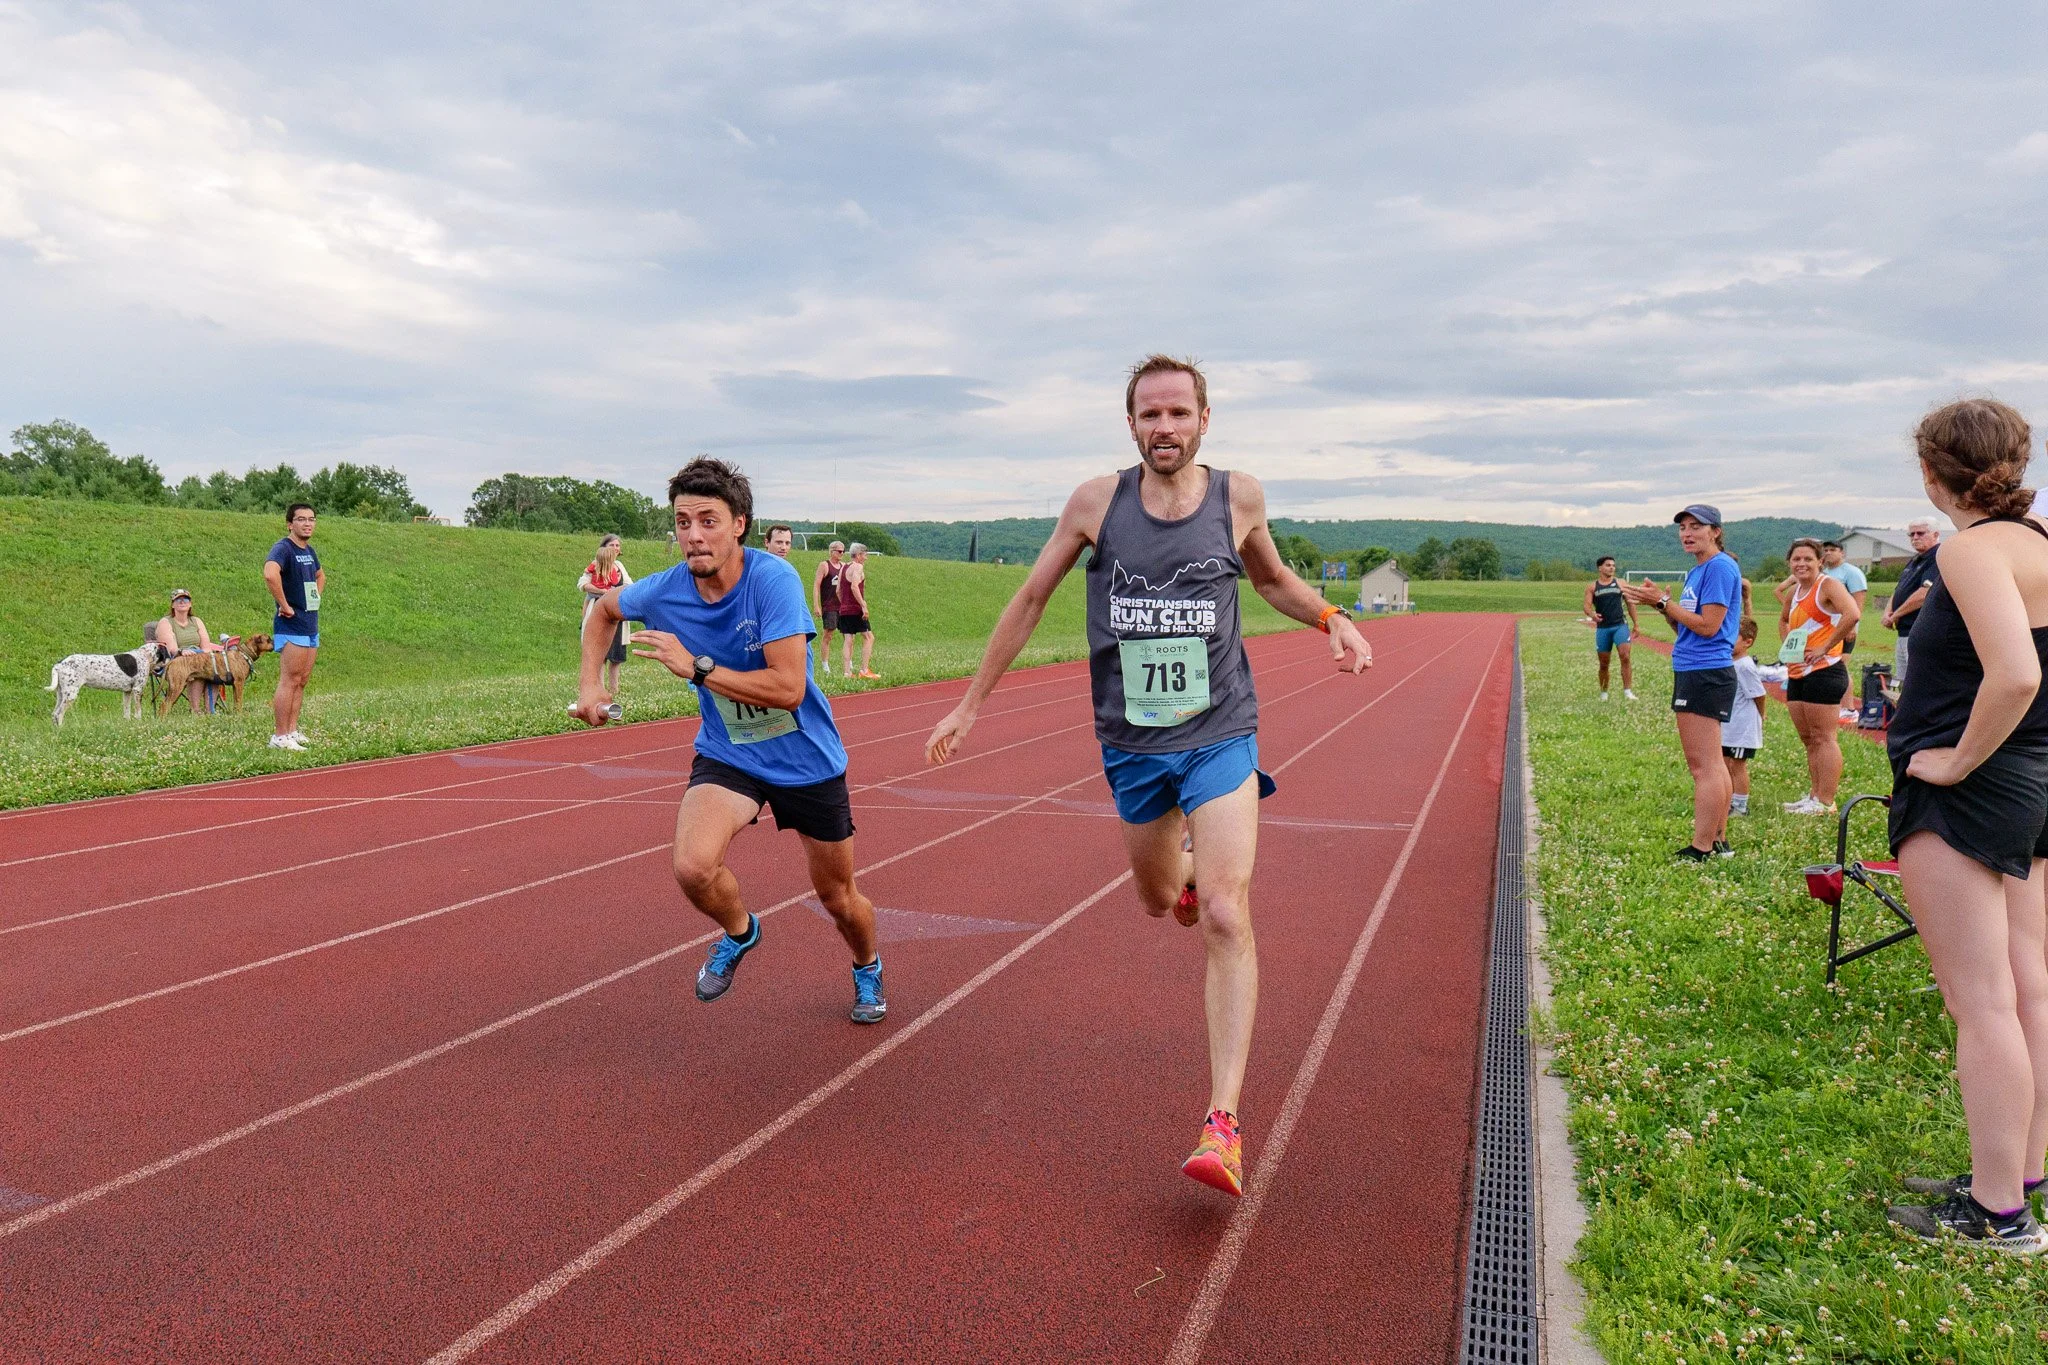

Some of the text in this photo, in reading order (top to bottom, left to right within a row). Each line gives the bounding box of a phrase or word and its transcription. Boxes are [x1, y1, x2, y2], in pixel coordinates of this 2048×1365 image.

[1110, 595, 1216, 610] CHRISTIANSBURG
[1110, 605, 1216, 626] RUN CLUB
[1136, 623, 1159, 632] DAY
[1172, 624, 1195, 633] HILL
[1196, 624, 1216, 633] DAY
[1156, 645, 1189, 654] ROOTS
[1141, 661, 1187, 692] 713
